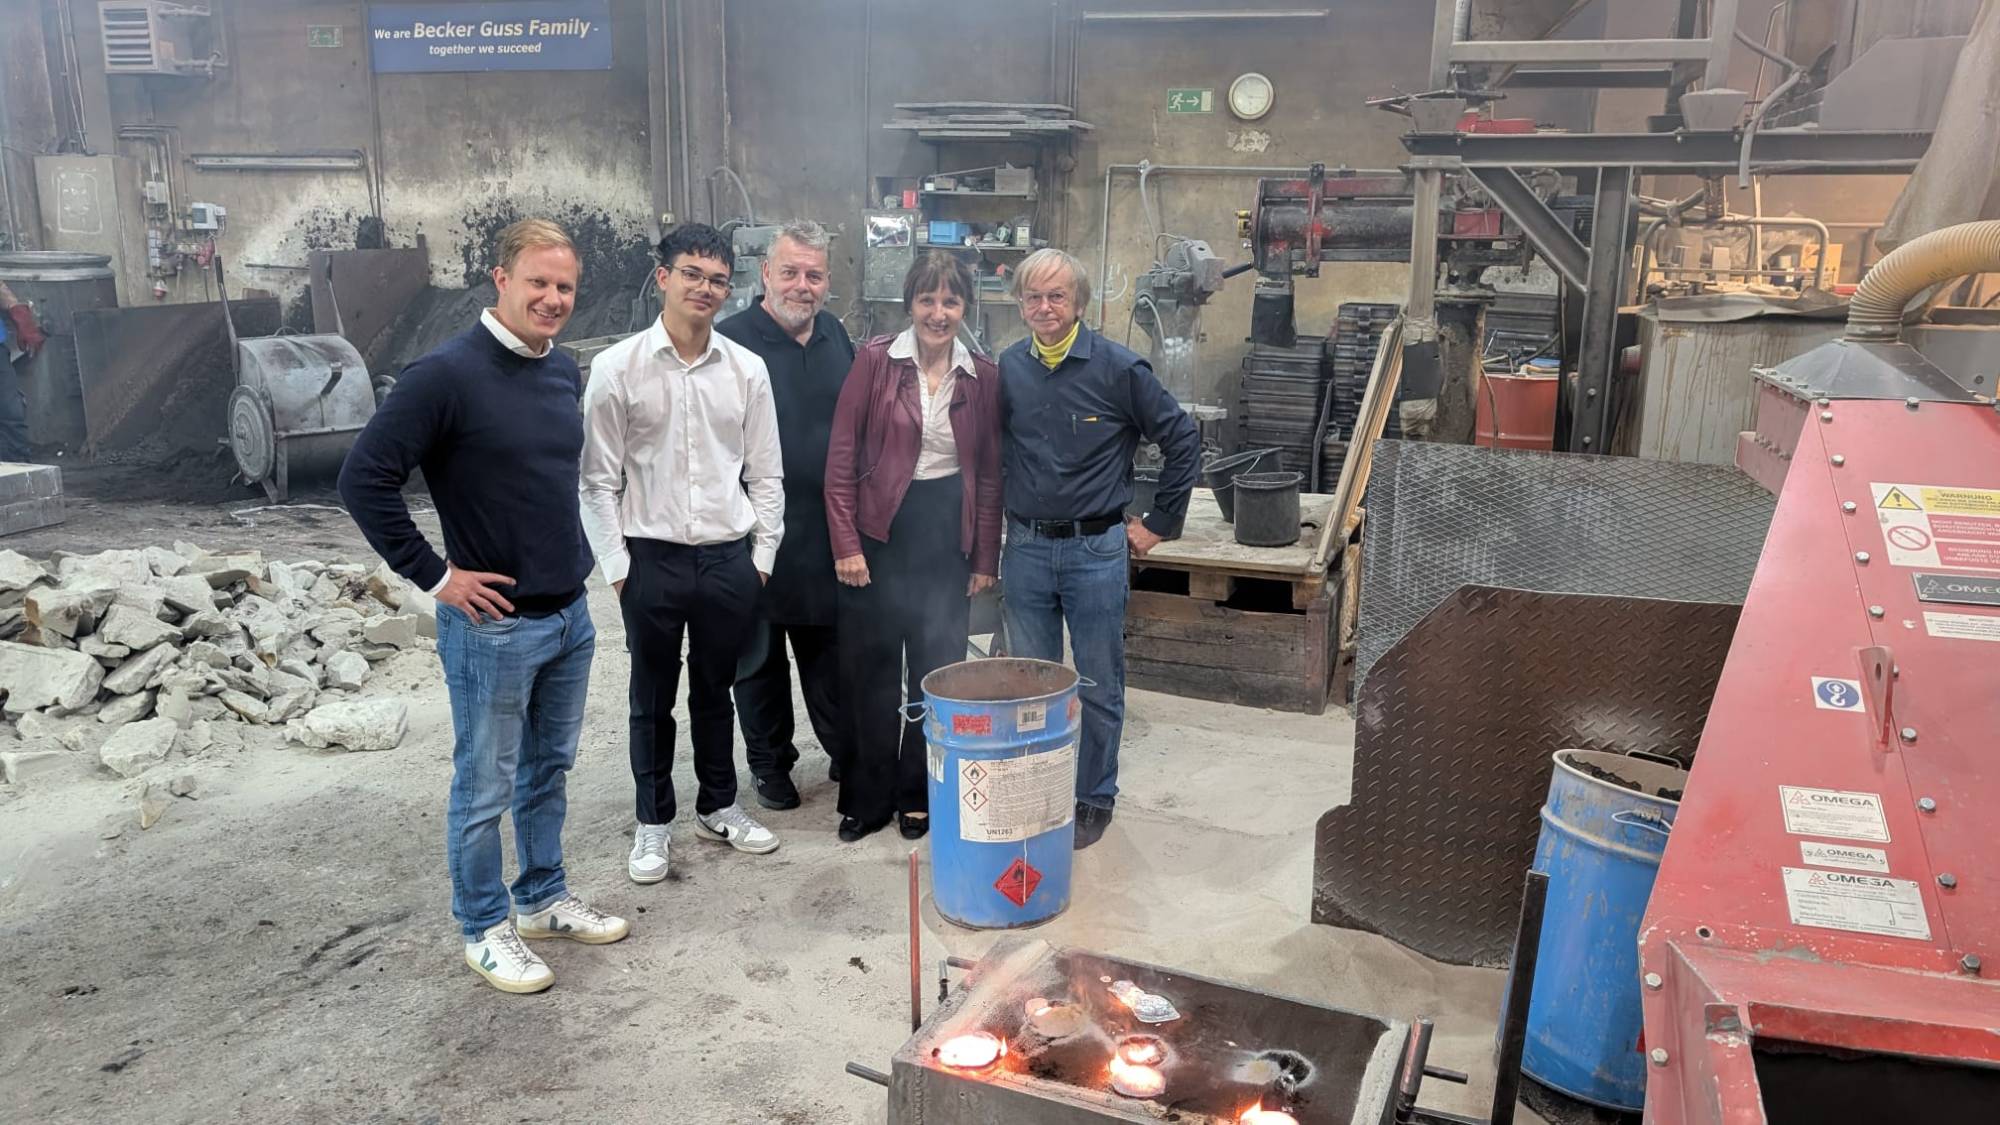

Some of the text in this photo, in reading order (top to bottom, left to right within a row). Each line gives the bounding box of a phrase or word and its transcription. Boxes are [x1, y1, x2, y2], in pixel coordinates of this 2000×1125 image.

[374, 29, 391, 39] We
[393, 30, 411, 39] are
[414, 21, 475, 38] Becker
[480, 21, 523, 37] Guss
[529, 18, 591, 38] Family
[429, 42, 542, 56] together we succeed
[1811, 794, 1874, 807] OMEGA
[1826, 849, 1875, 860] OMEGA
